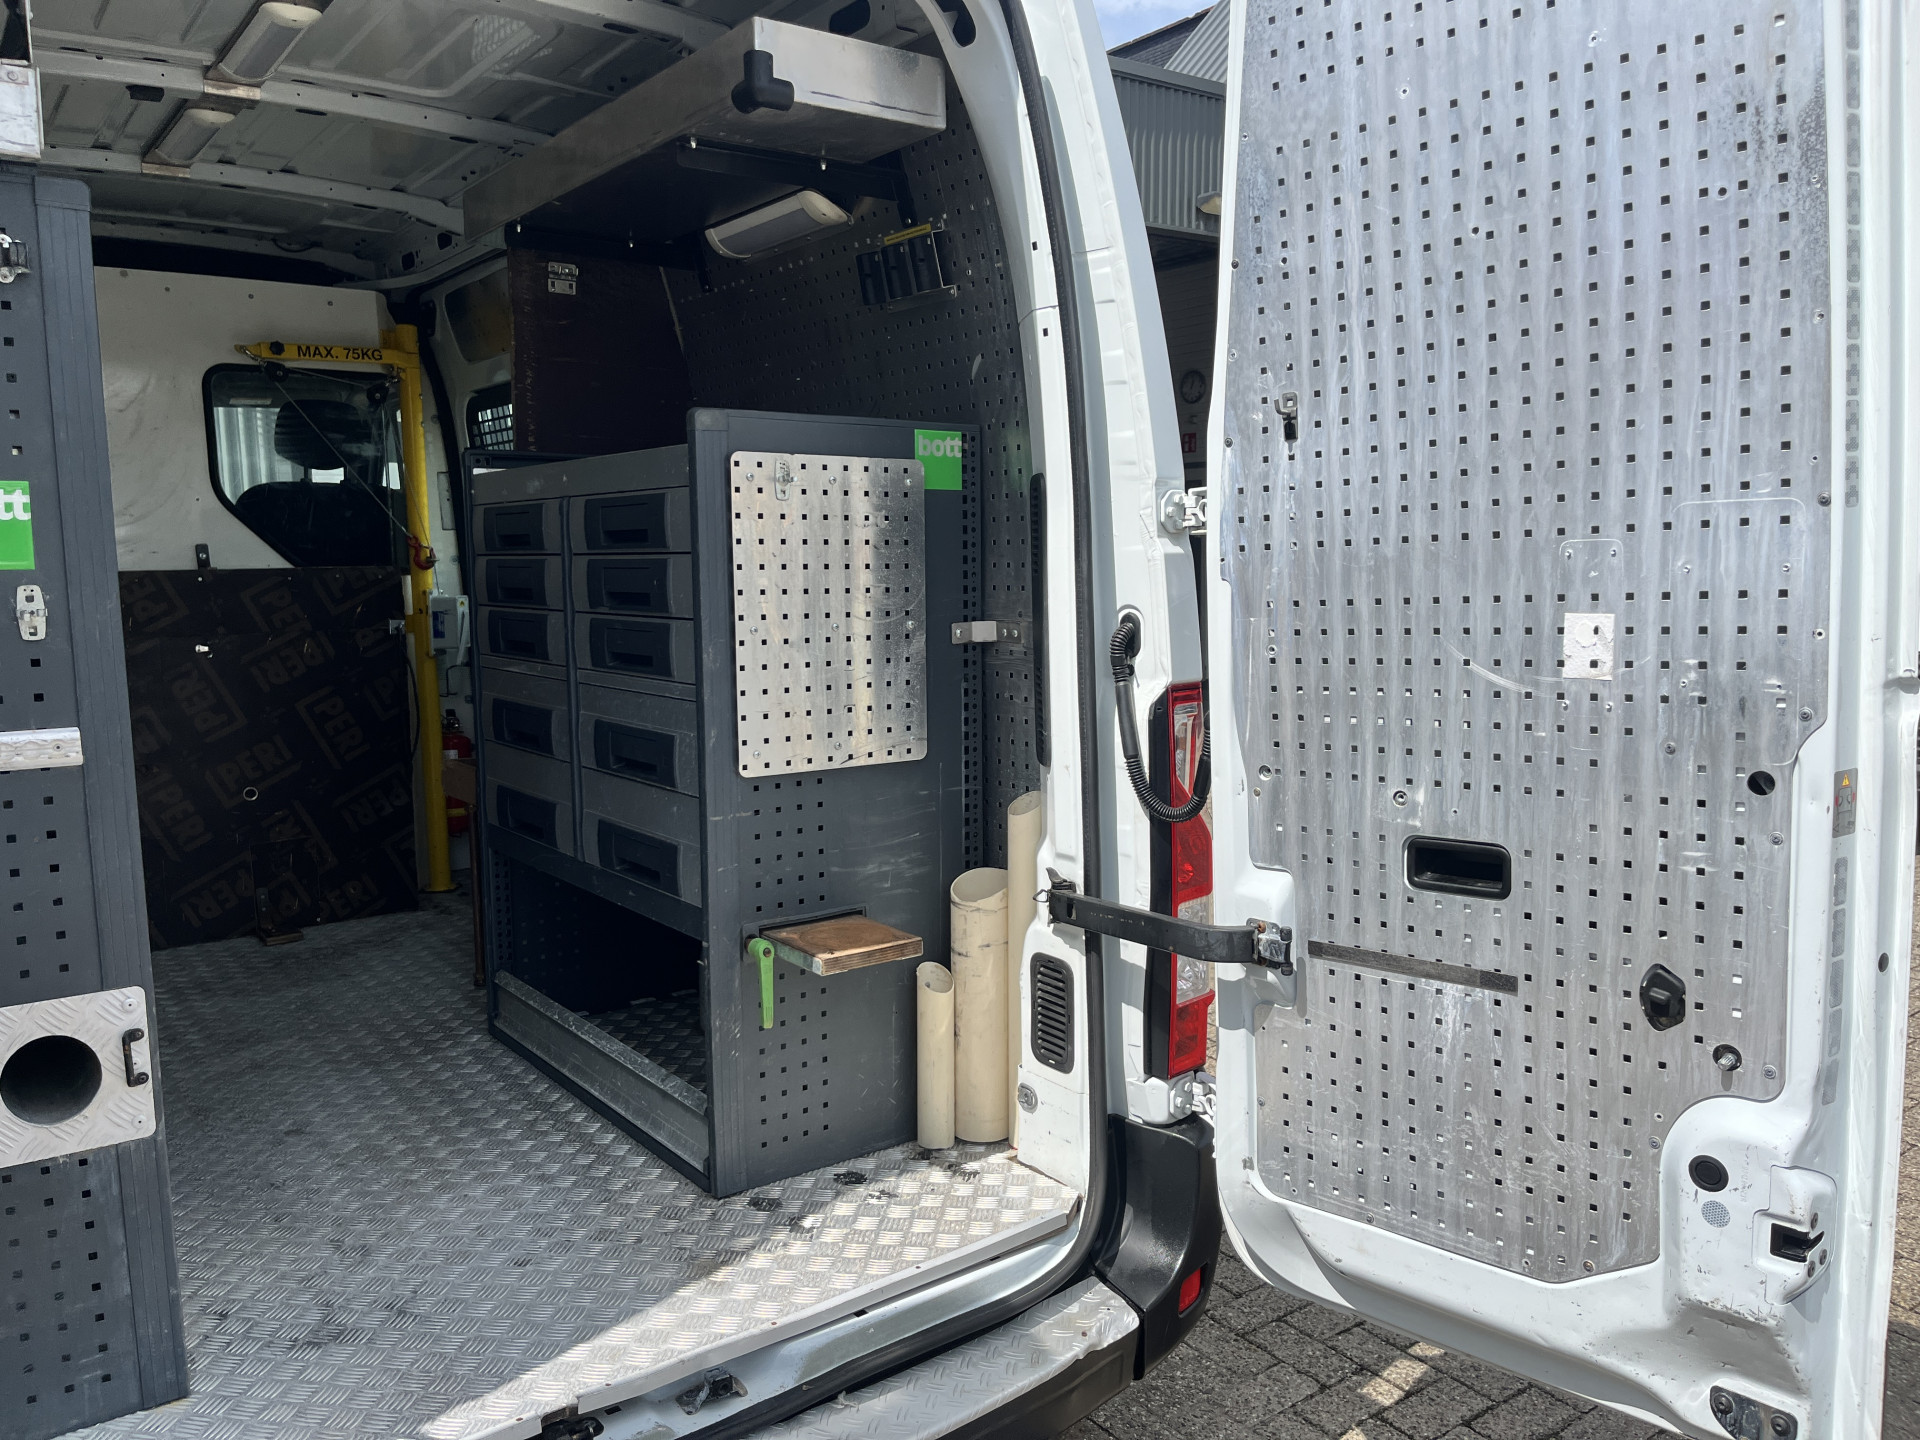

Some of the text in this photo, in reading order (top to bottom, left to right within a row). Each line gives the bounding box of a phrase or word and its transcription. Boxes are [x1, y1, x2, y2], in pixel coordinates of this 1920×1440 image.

[297, 345, 383, 361] MAX. 75KG
[918, 435, 962, 458] bott
[250, 638, 325, 693] PERI
[163, 662, 229, 734] PERI
[313, 696, 370, 761] PERI
[217, 735, 293, 793] PERI
[148, 783, 214, 852] PERI
